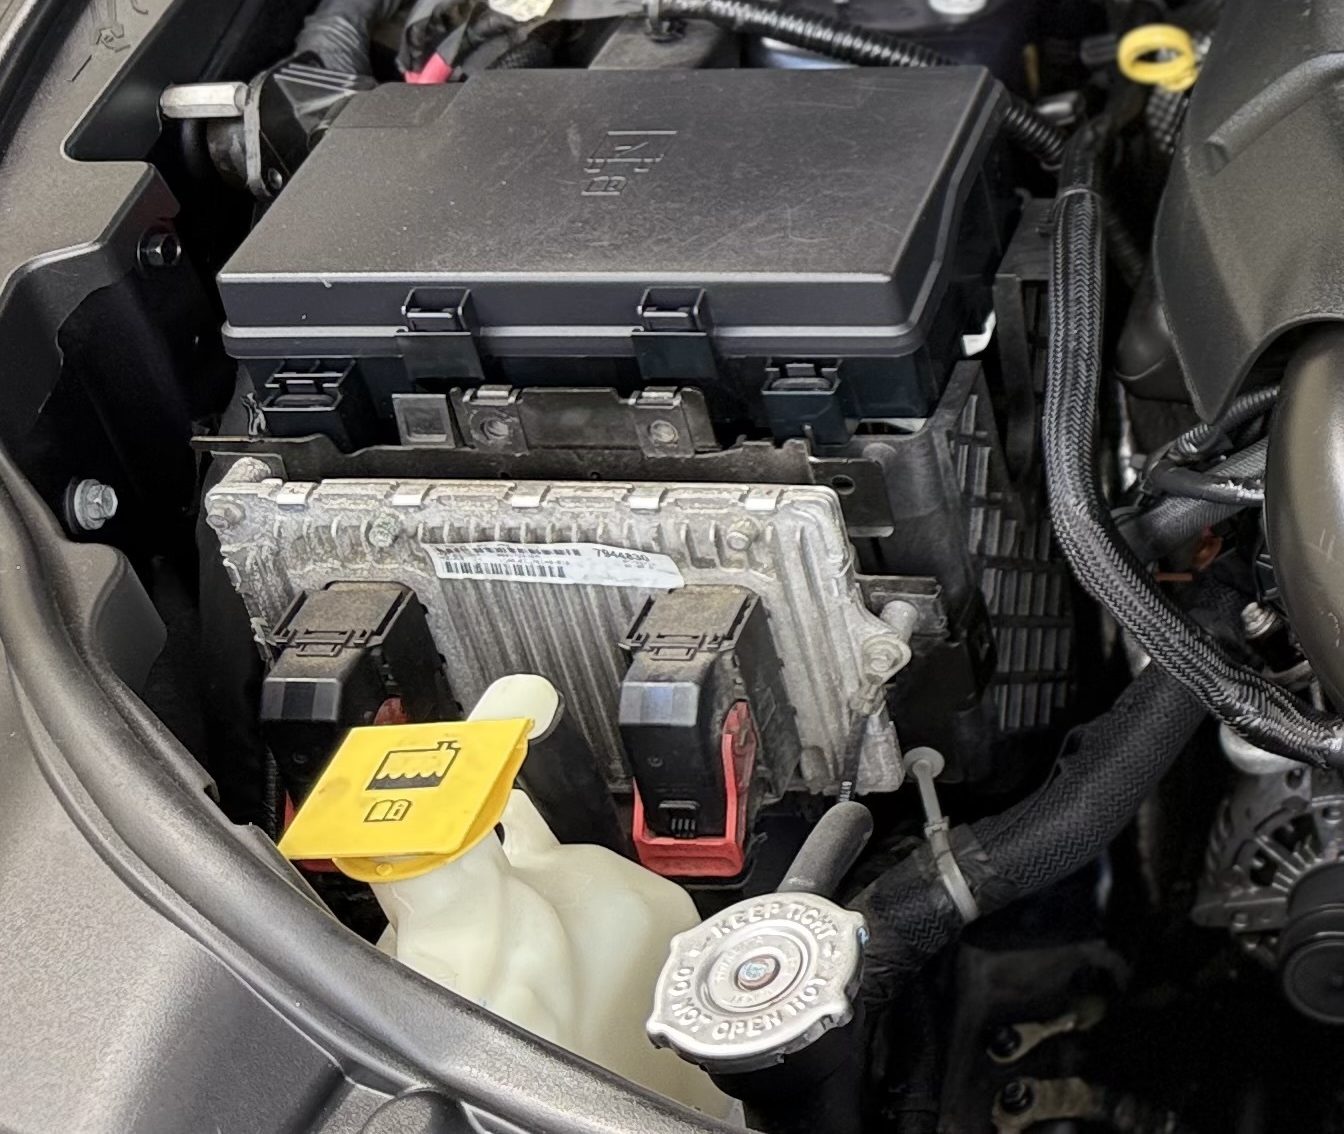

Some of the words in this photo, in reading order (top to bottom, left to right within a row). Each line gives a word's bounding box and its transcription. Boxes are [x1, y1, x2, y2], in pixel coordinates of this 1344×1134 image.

[710, 902, 783, 939] KEEP
[785, 902, 838, 940] TIGHT
[671, 997, 713, 1033] NOT
[712, 1008, 784, 1040] OPEN
[784, 975, 827, 1016] HOT
